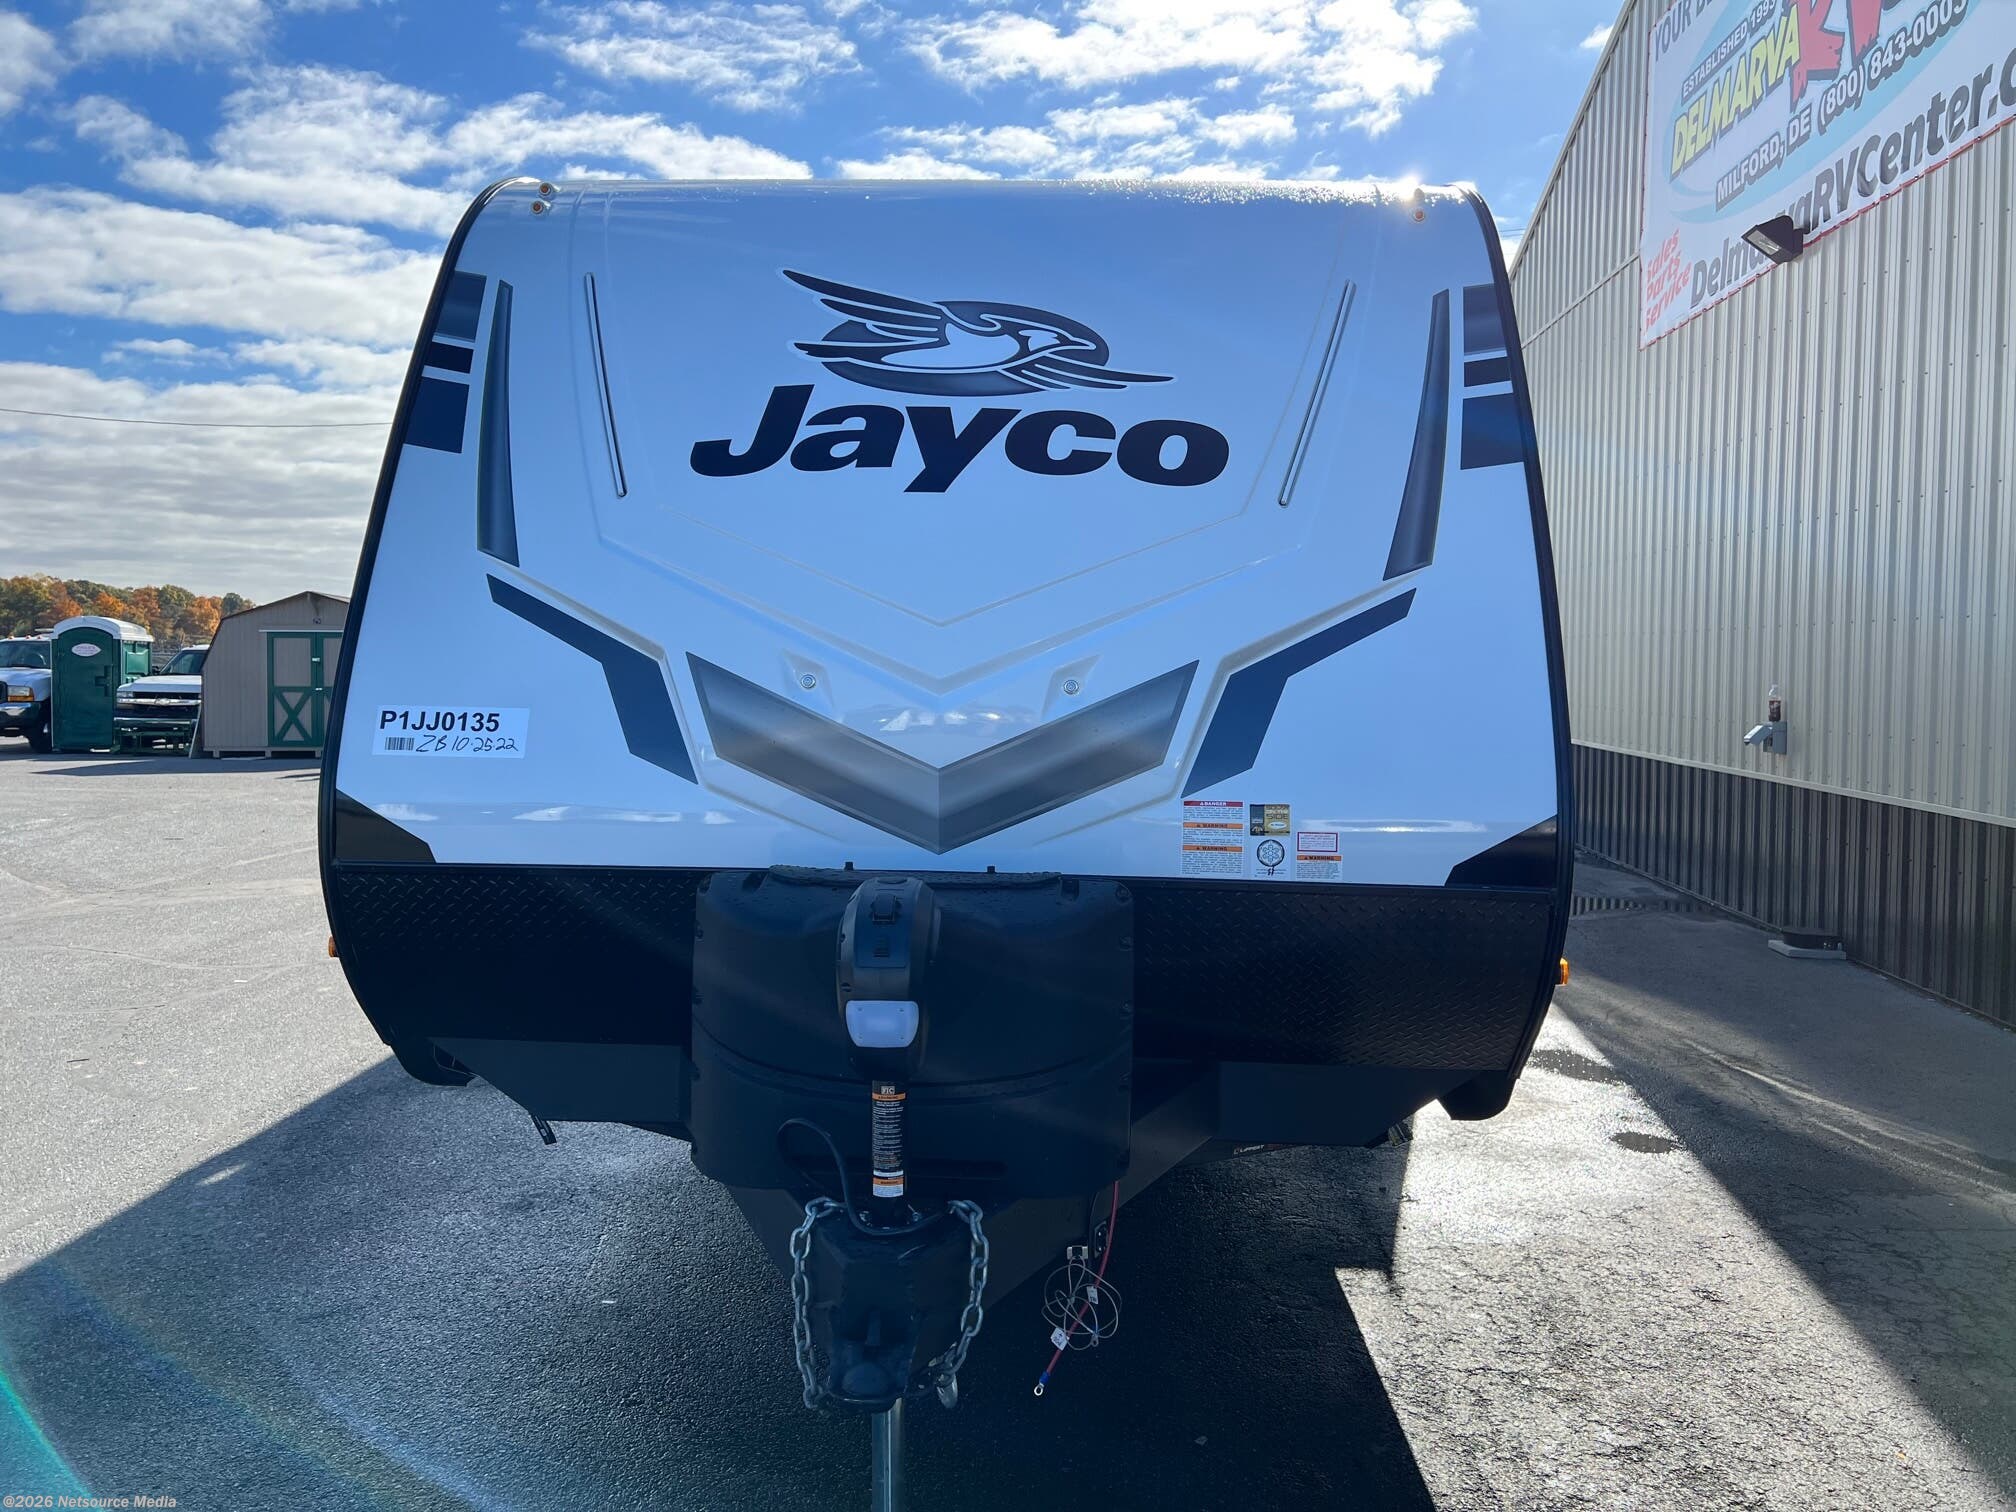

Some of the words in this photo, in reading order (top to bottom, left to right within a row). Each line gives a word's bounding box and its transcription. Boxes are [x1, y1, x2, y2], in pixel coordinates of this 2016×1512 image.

[1655, 0, 1692, 62] YOUR
[1682, 22, 1749, 98] ESTABLISHED
[1671, 4, 1800, 177] DELMARVA
[1717, 134, 1785, 204] MILFORD,
[1788, 107, 1812, 146] DE
[1821, 64, 1865, 126] (800)
[689, 383, 1230, 493] Jayco
[379, 710, 500, 733] P1JJ0135
